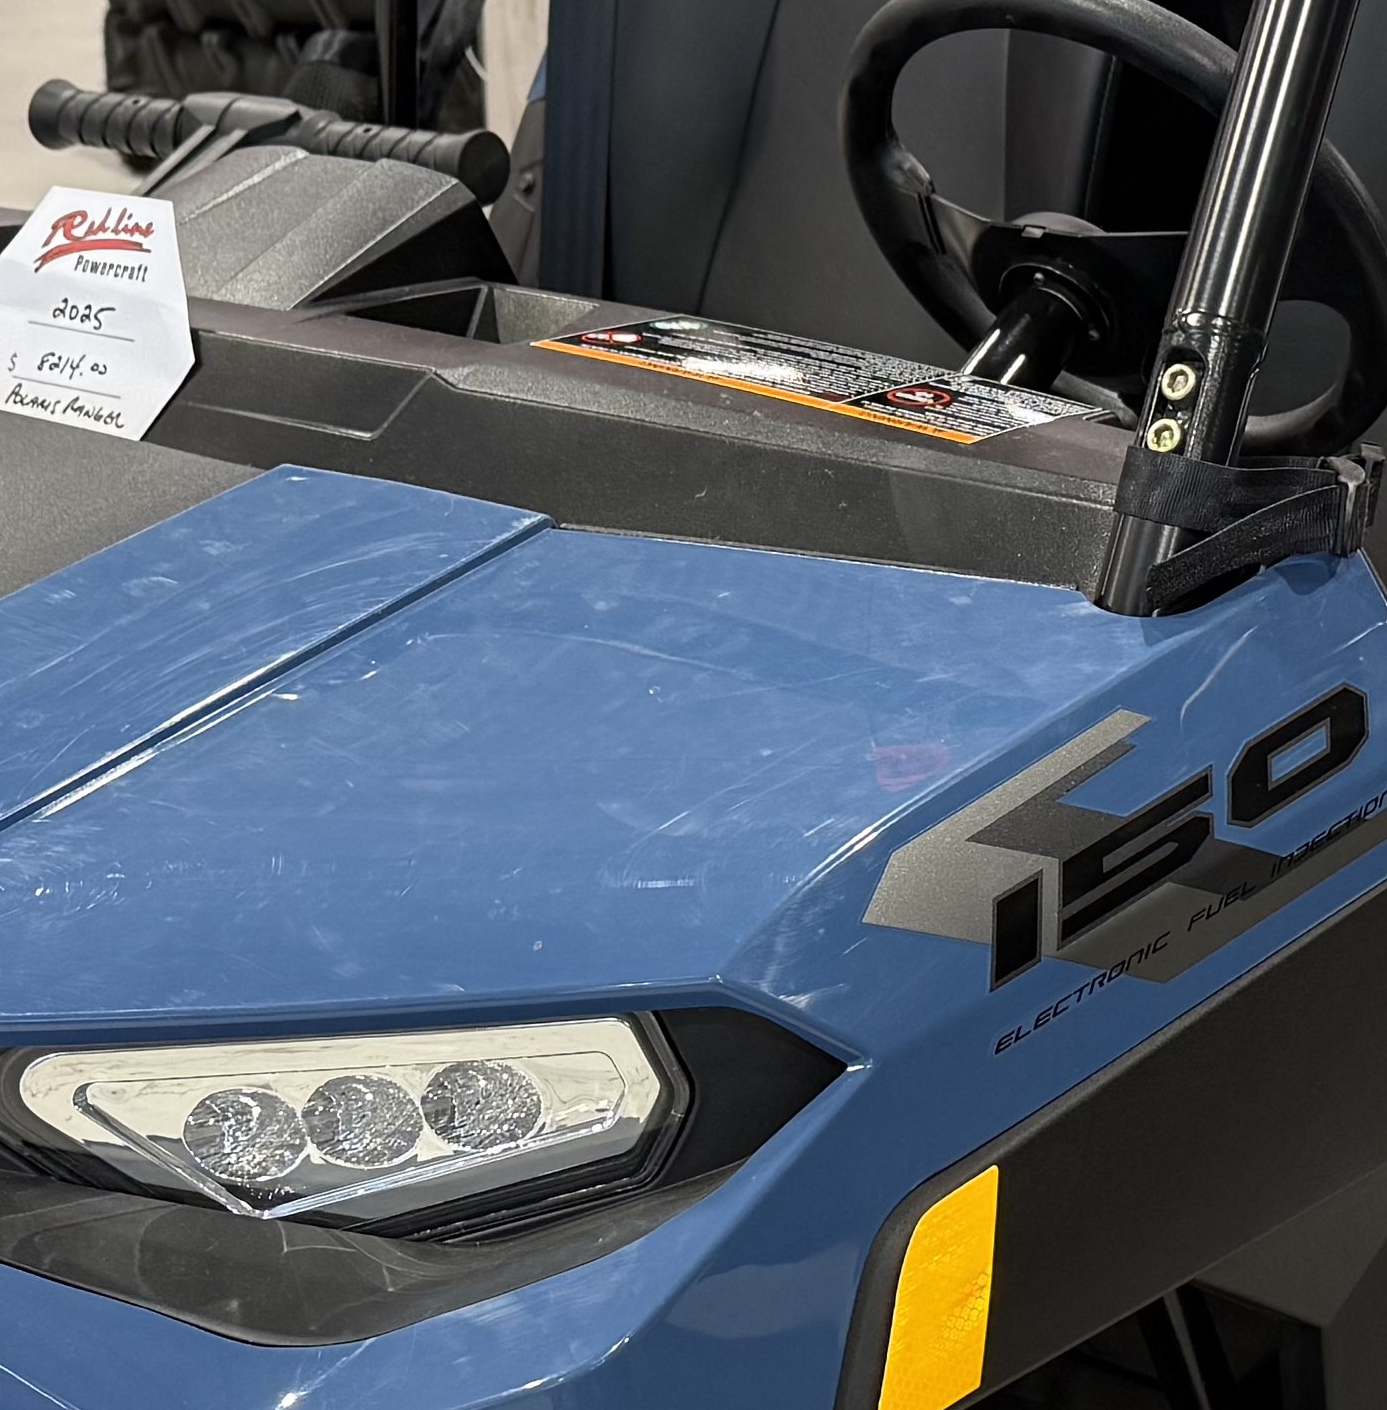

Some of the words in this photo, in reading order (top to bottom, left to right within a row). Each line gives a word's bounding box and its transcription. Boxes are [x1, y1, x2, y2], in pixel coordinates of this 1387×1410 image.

[52, 297, 117, 331] 2025
[74, 254, 149, 283] Powercraft
[988, 681, 1370, 993] 150
[993, 931, 1171, 1056] ELECTRONIC
[1186, 879, 1258, 932] FUEL
